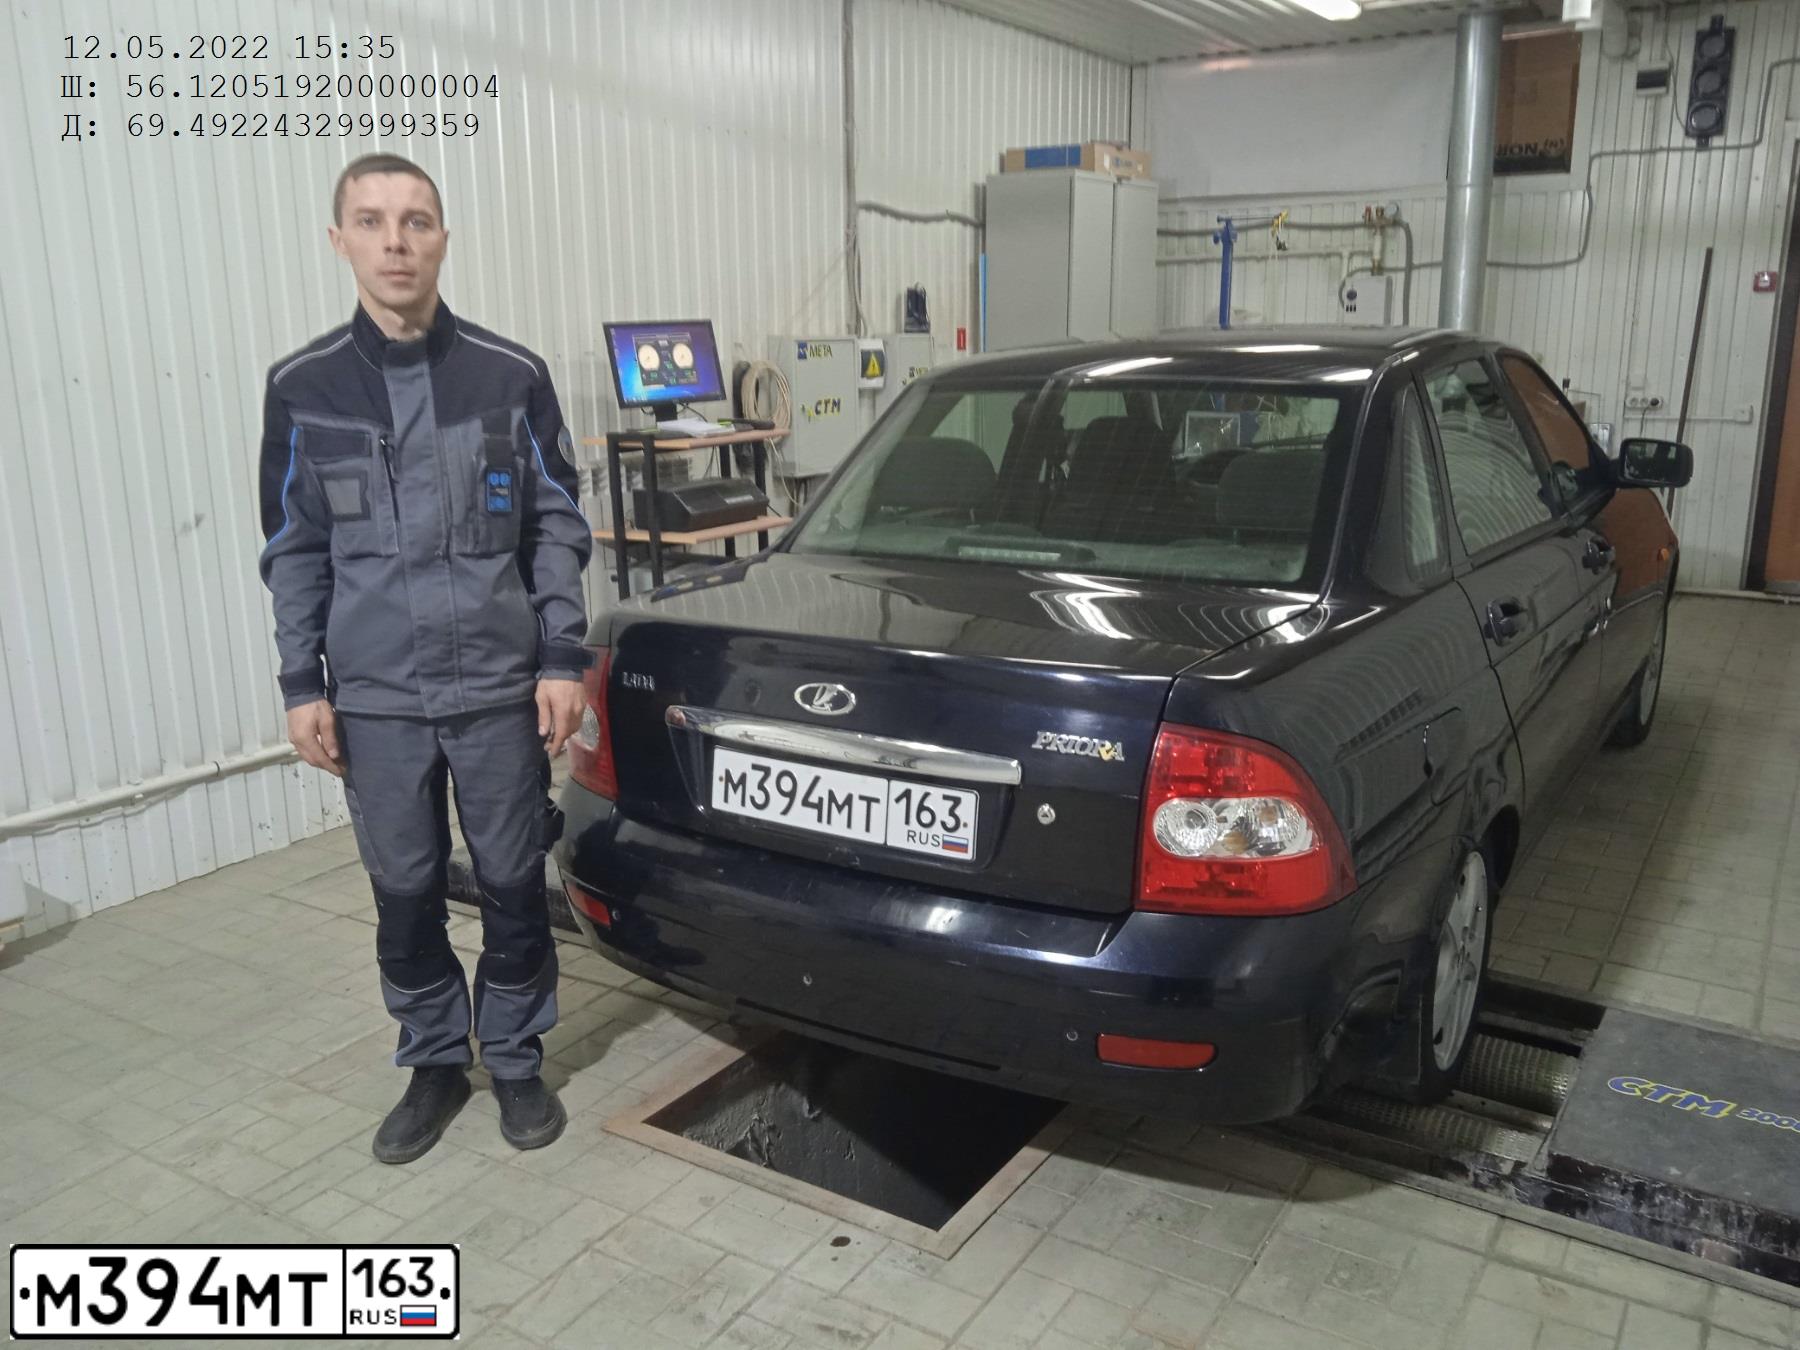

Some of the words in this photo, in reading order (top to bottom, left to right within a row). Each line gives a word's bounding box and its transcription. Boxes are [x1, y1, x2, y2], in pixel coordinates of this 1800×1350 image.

[1031, 730, 1125, 762] PRIORA
[894, 788, 962, 833] 163
[906, 829, 940, 848] RUS
